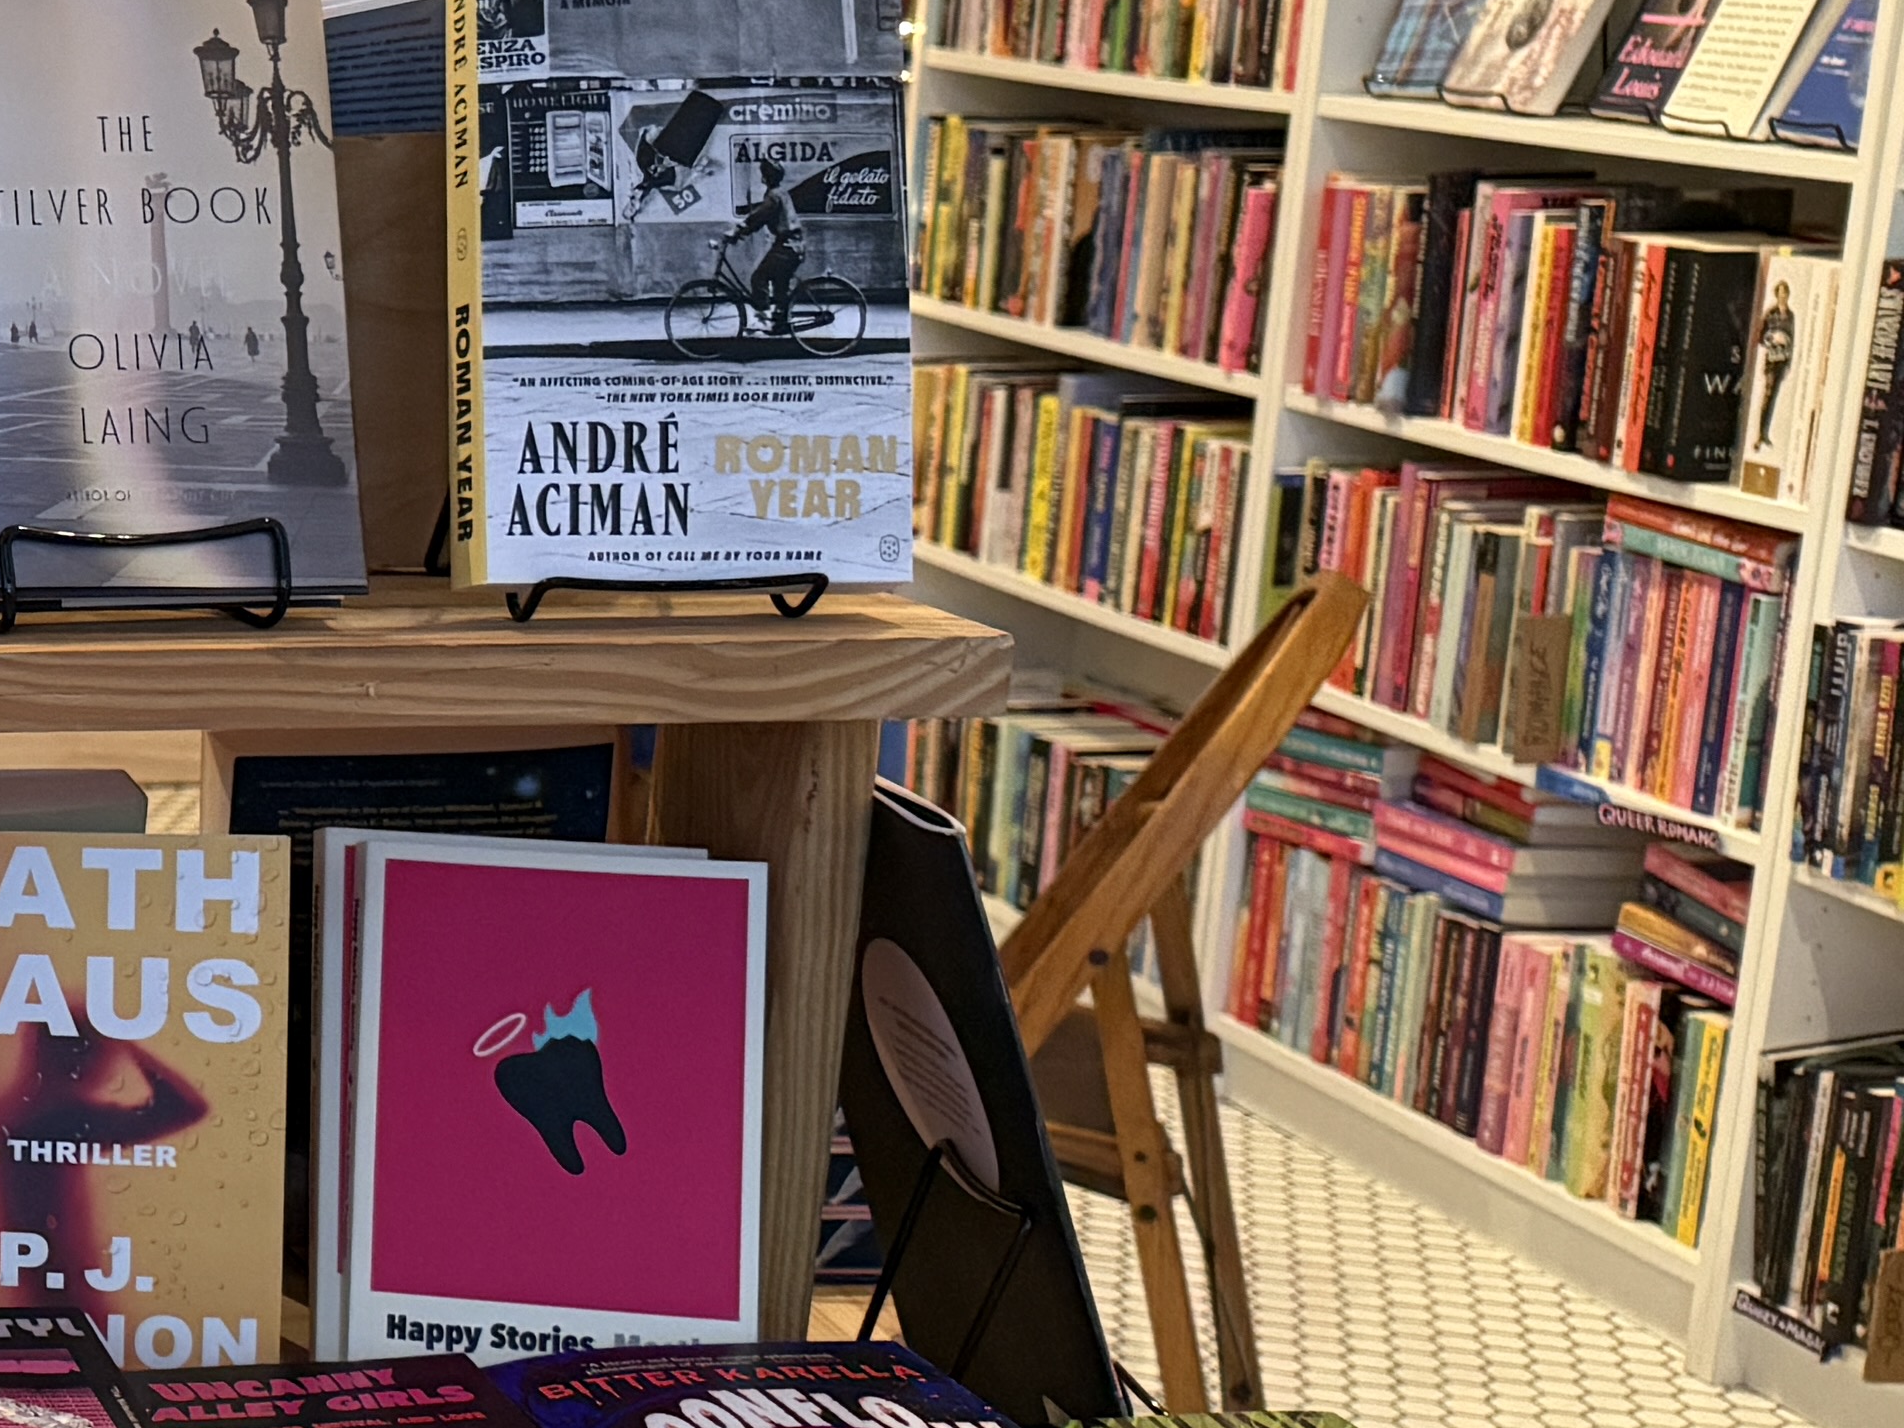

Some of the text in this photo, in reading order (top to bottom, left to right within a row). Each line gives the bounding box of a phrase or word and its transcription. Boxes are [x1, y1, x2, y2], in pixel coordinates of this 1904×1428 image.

[729, 98, 831, 124] cremino
[97, 115, 155, 154] THE
[142, 186, 272, 225] BOOK
[69, 334, 213, 371] OLIVIA
[82, 407, 210, 445] LAING
[518, 412, 679, 474] ANDRÉ
[715, 435, 897, 473] ROMAN
[505, 483, 691, 536] ACIMAN
[749, 479, 862, 519] YEAR
[1599, 803, 1656, 834] QUEER
[7, 1138, 177, 1169] THRILLER
[540, 1370, 703, 1408] BITTER
[717, 1360, 922, 1383] KARELLA
